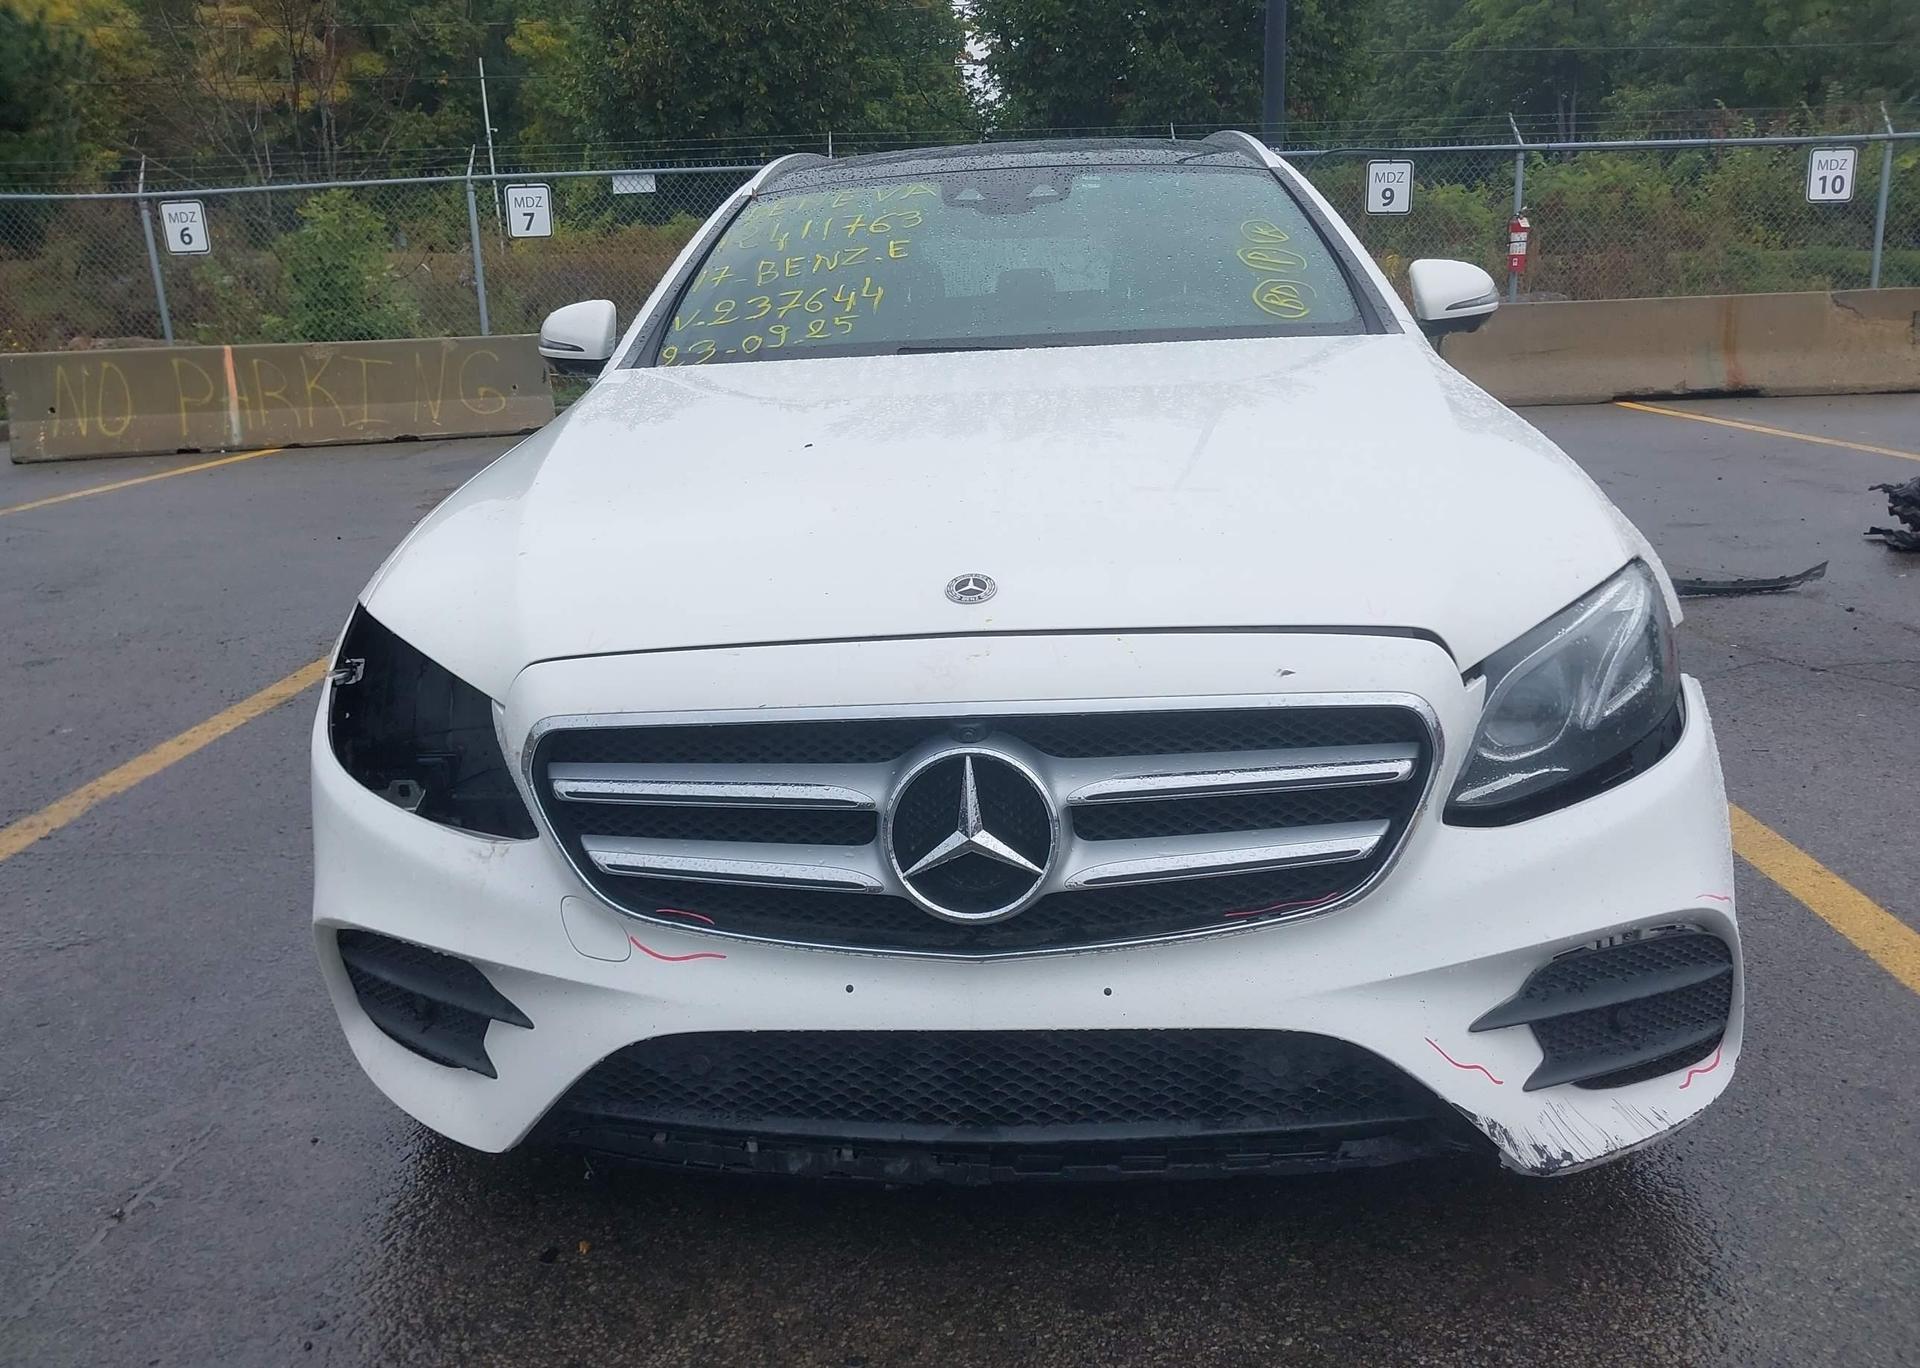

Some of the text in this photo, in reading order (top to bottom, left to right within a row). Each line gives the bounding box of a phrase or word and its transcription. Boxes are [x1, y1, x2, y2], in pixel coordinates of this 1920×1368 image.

[1817, 158, 1848, 171] MDZ
[1374, 171, 1405, 184] MDZ
[1818, 174, 1845, 195] 10
[514, 195, 544, 208] MDZ
[1381, 187, 1395, 207] 9
[168, 211, 198, 224] MDZ
[522, 212, 535, 231] 7
[180, 227, 193, 246] 6
[51, 350, 506, 437] NO PARKING
